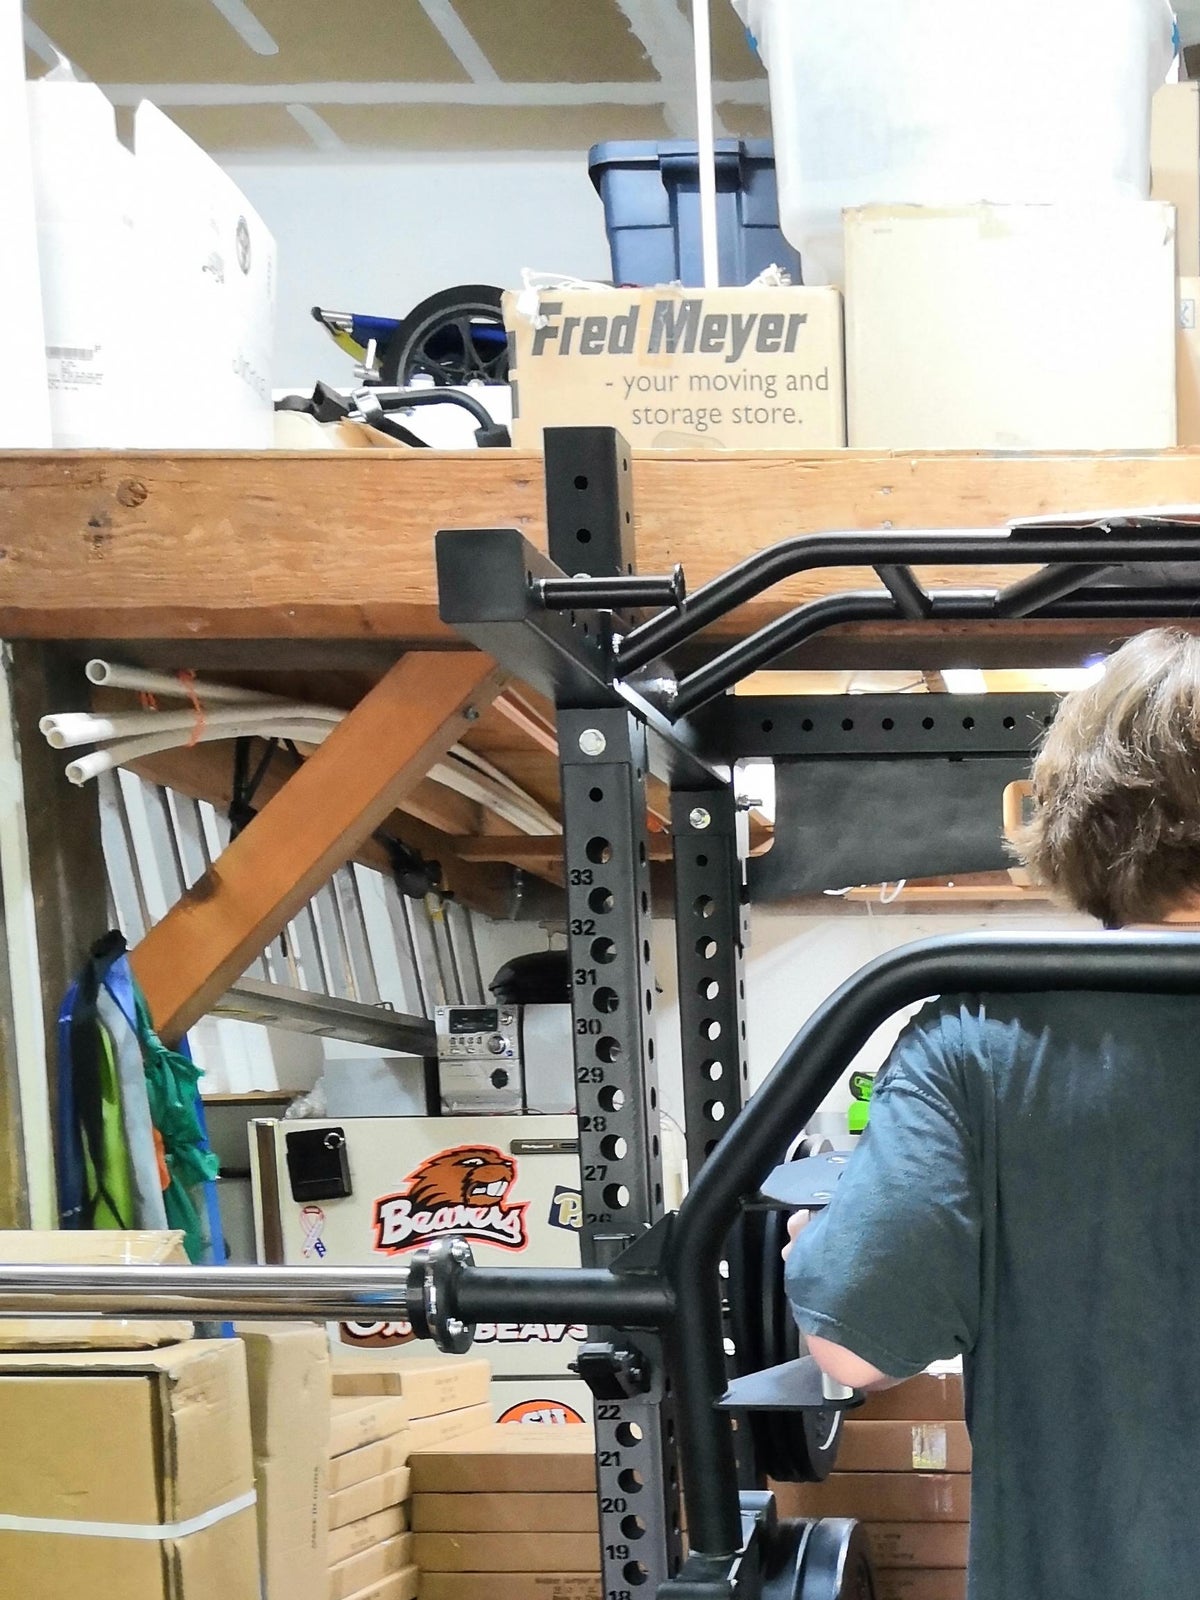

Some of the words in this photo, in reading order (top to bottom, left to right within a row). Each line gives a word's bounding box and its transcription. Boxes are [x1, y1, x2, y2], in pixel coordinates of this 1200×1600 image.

[531, 301, 640, 356] Fred
[647, 299, 808, 363] Meyer
[623, 374, 679, 399] your
[688, 367, 777, 399] moving
[786, 366, 829, 392] and
[632, 406, 722, 432] storage
[732, 406, 803, 424] store.
[571, 869, 593, 886] 33
[571, 919, 596, 936] 32
[575, 968, 597, 985] 31
[576, 1018, 601, 1035] 30
[578, 1067, 604, 1084] 29
[584, 1165, 608, 1182] 27
[380, 1198, 523, 1247] Beavers
[597, 1405, 621, 1420] 22
[599, 1451, 620, 1467] 21
[601, 1497, 627, 1513] 20
[607, 1544, 629, 1560] 19
